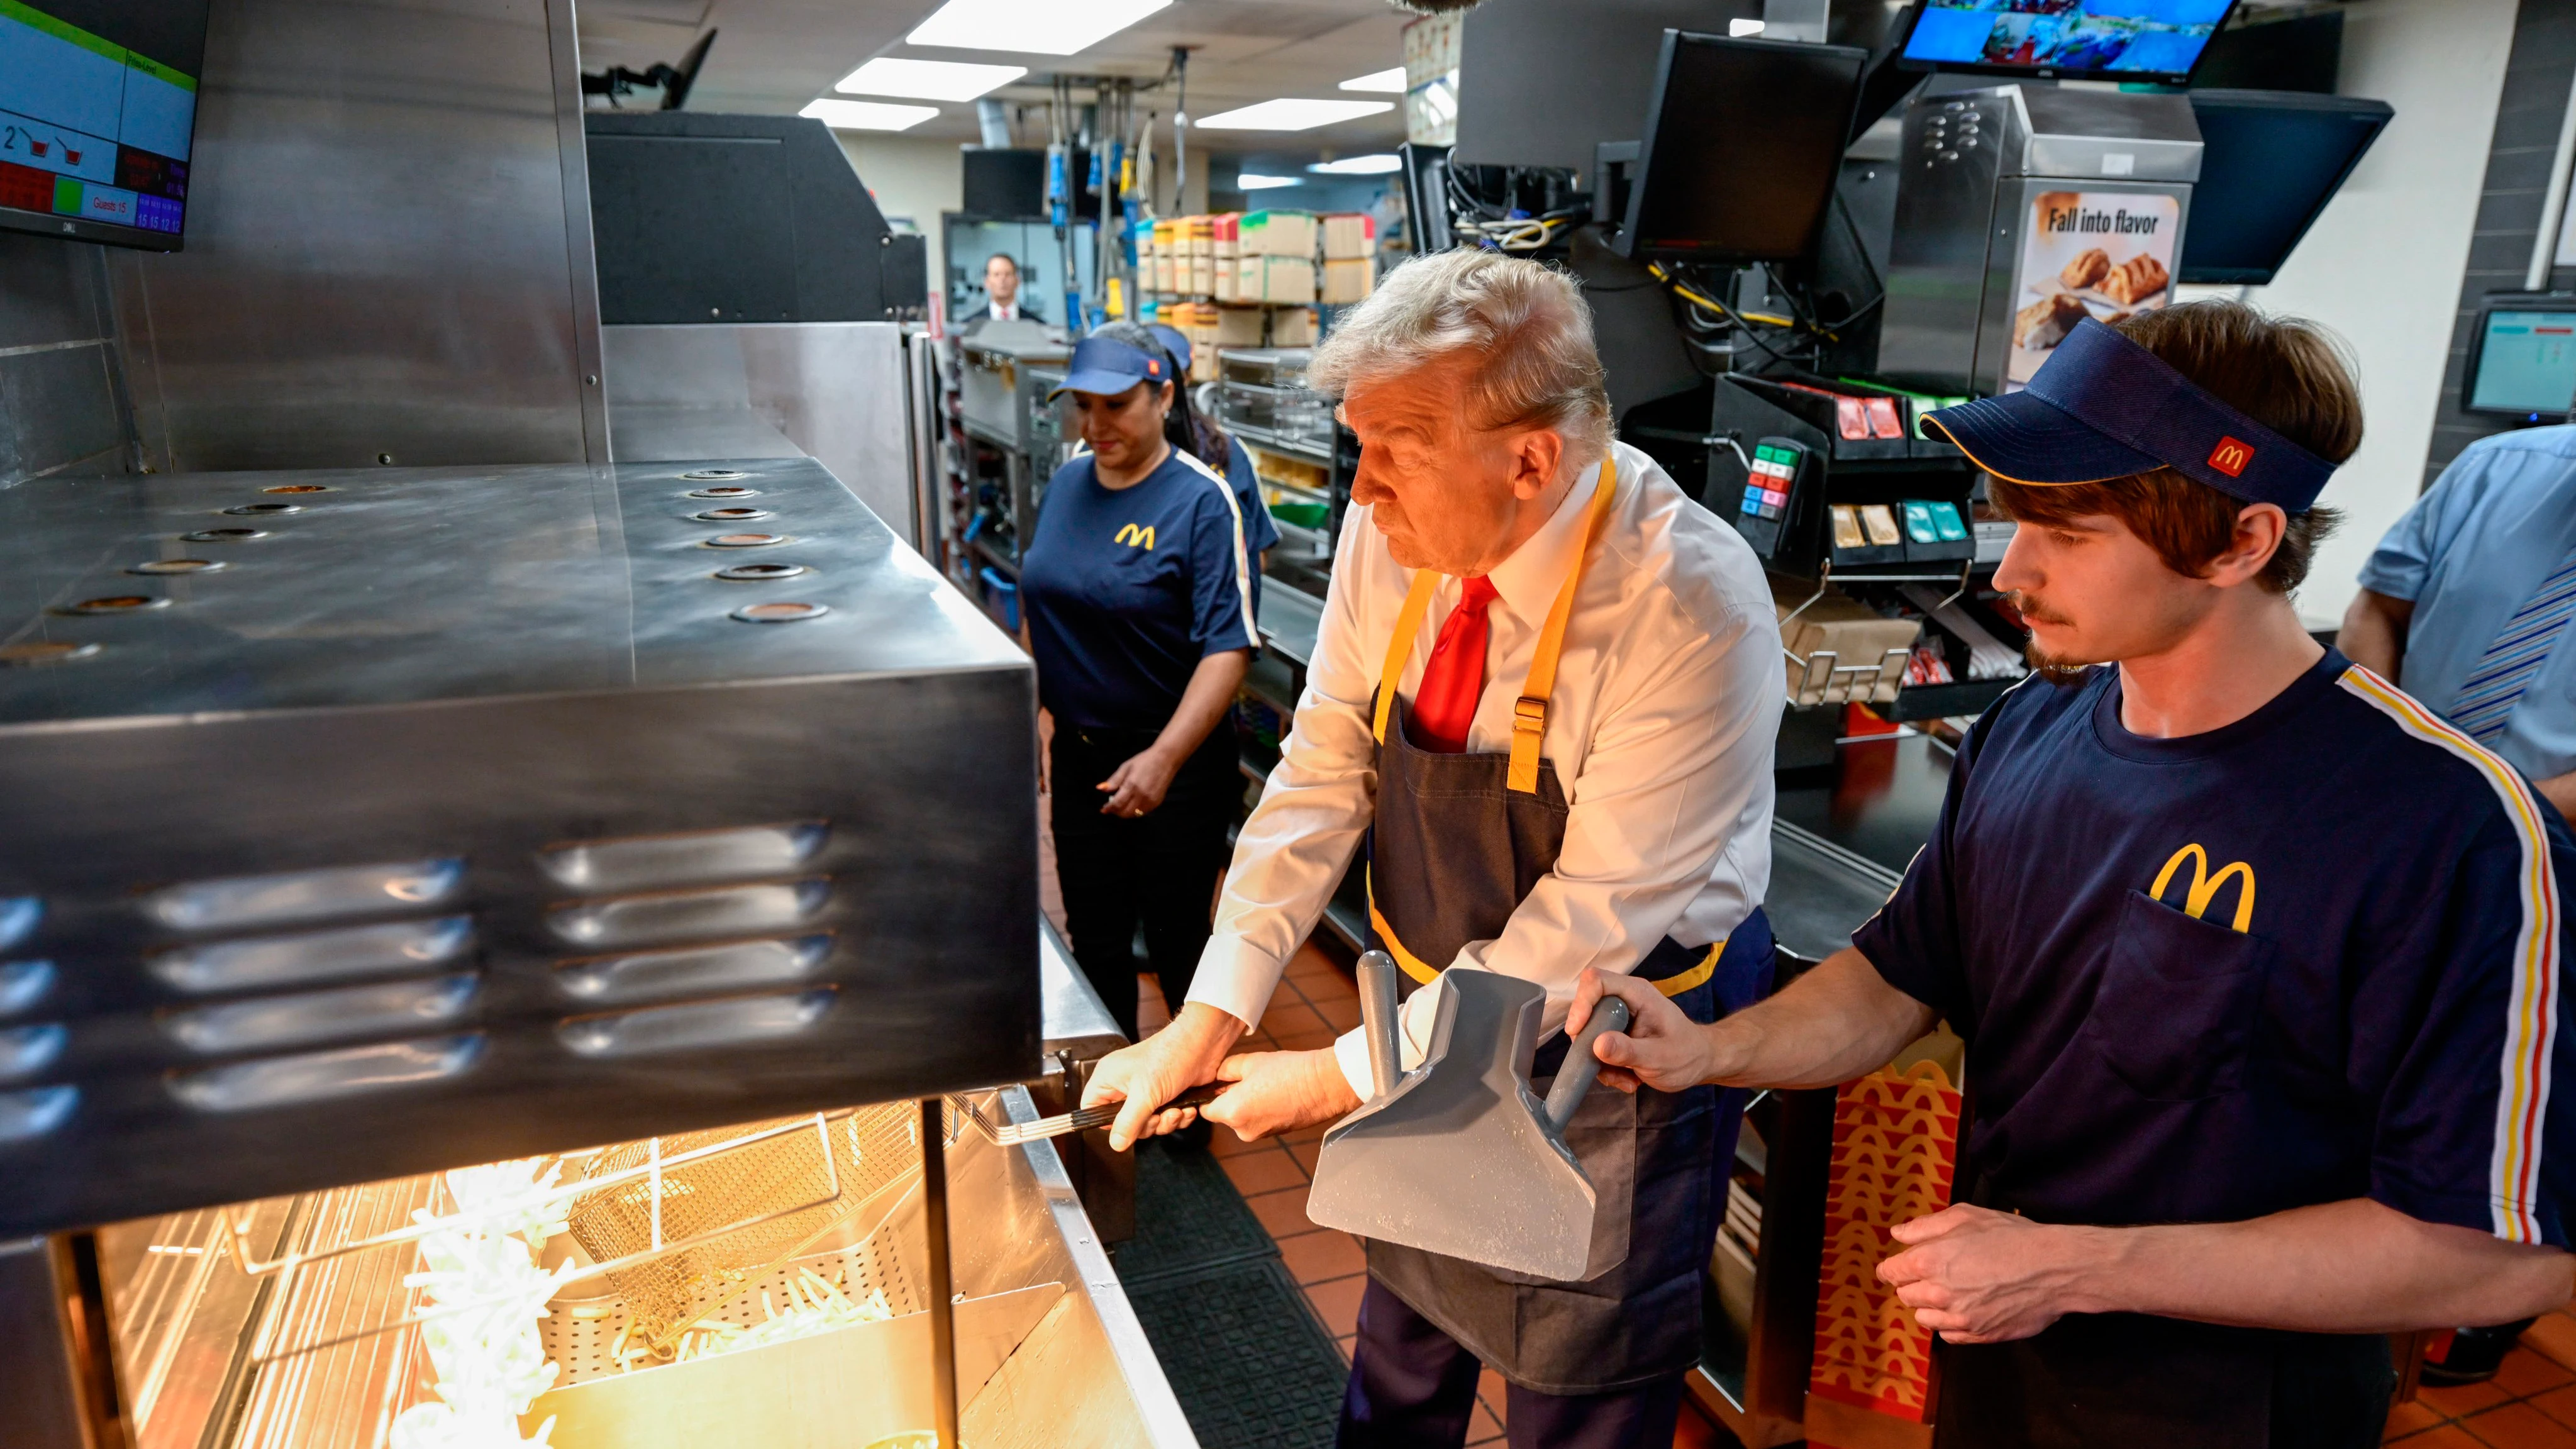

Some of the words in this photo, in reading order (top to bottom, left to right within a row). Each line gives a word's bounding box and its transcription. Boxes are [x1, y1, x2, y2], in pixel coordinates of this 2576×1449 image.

[4, 125, 15, 150] 2
[94, 197, 116, 212] Guests
[118, 202, 126, 213] 15
[2048, 208, 2078, 233] Fall
[2080, 208, 2111, 233] into
[2114, 209, 2158, 234] flavor
